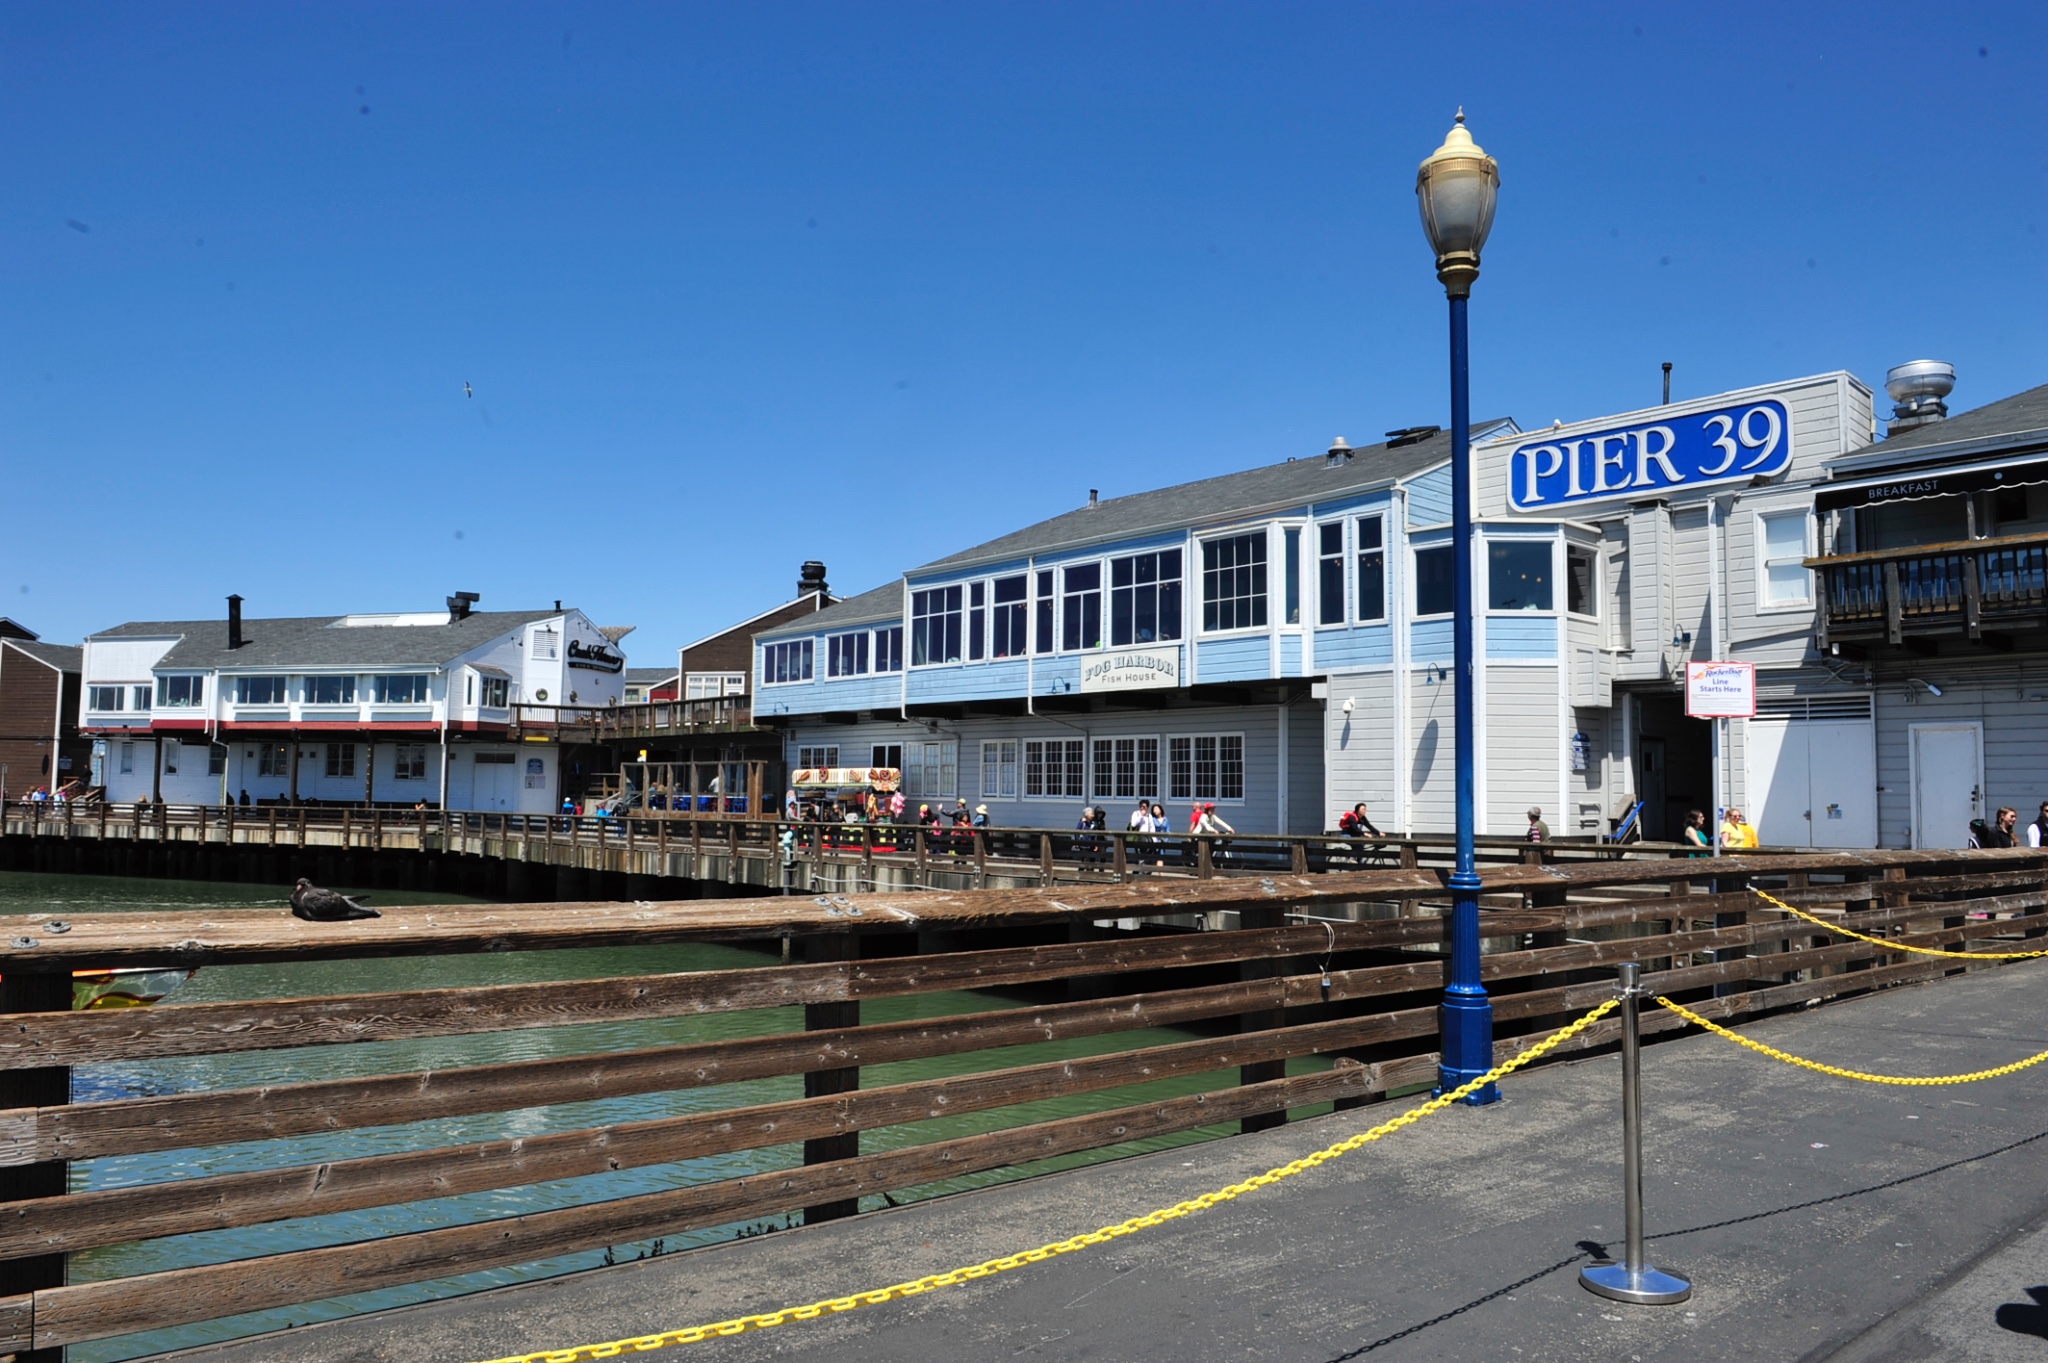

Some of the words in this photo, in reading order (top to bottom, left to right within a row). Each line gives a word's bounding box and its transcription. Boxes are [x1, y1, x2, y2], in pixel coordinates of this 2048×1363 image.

[1519, 425, 1686, 503] PIER
[1698, 406, 1781, 476] 39
[1868, 480, 1939, 499] BREAKFAST
[1085, 660, 1111, 682] FOG
[1114, 655, 1174, 677] HARBOR
[1700, 685, 1722, 693] Starts
